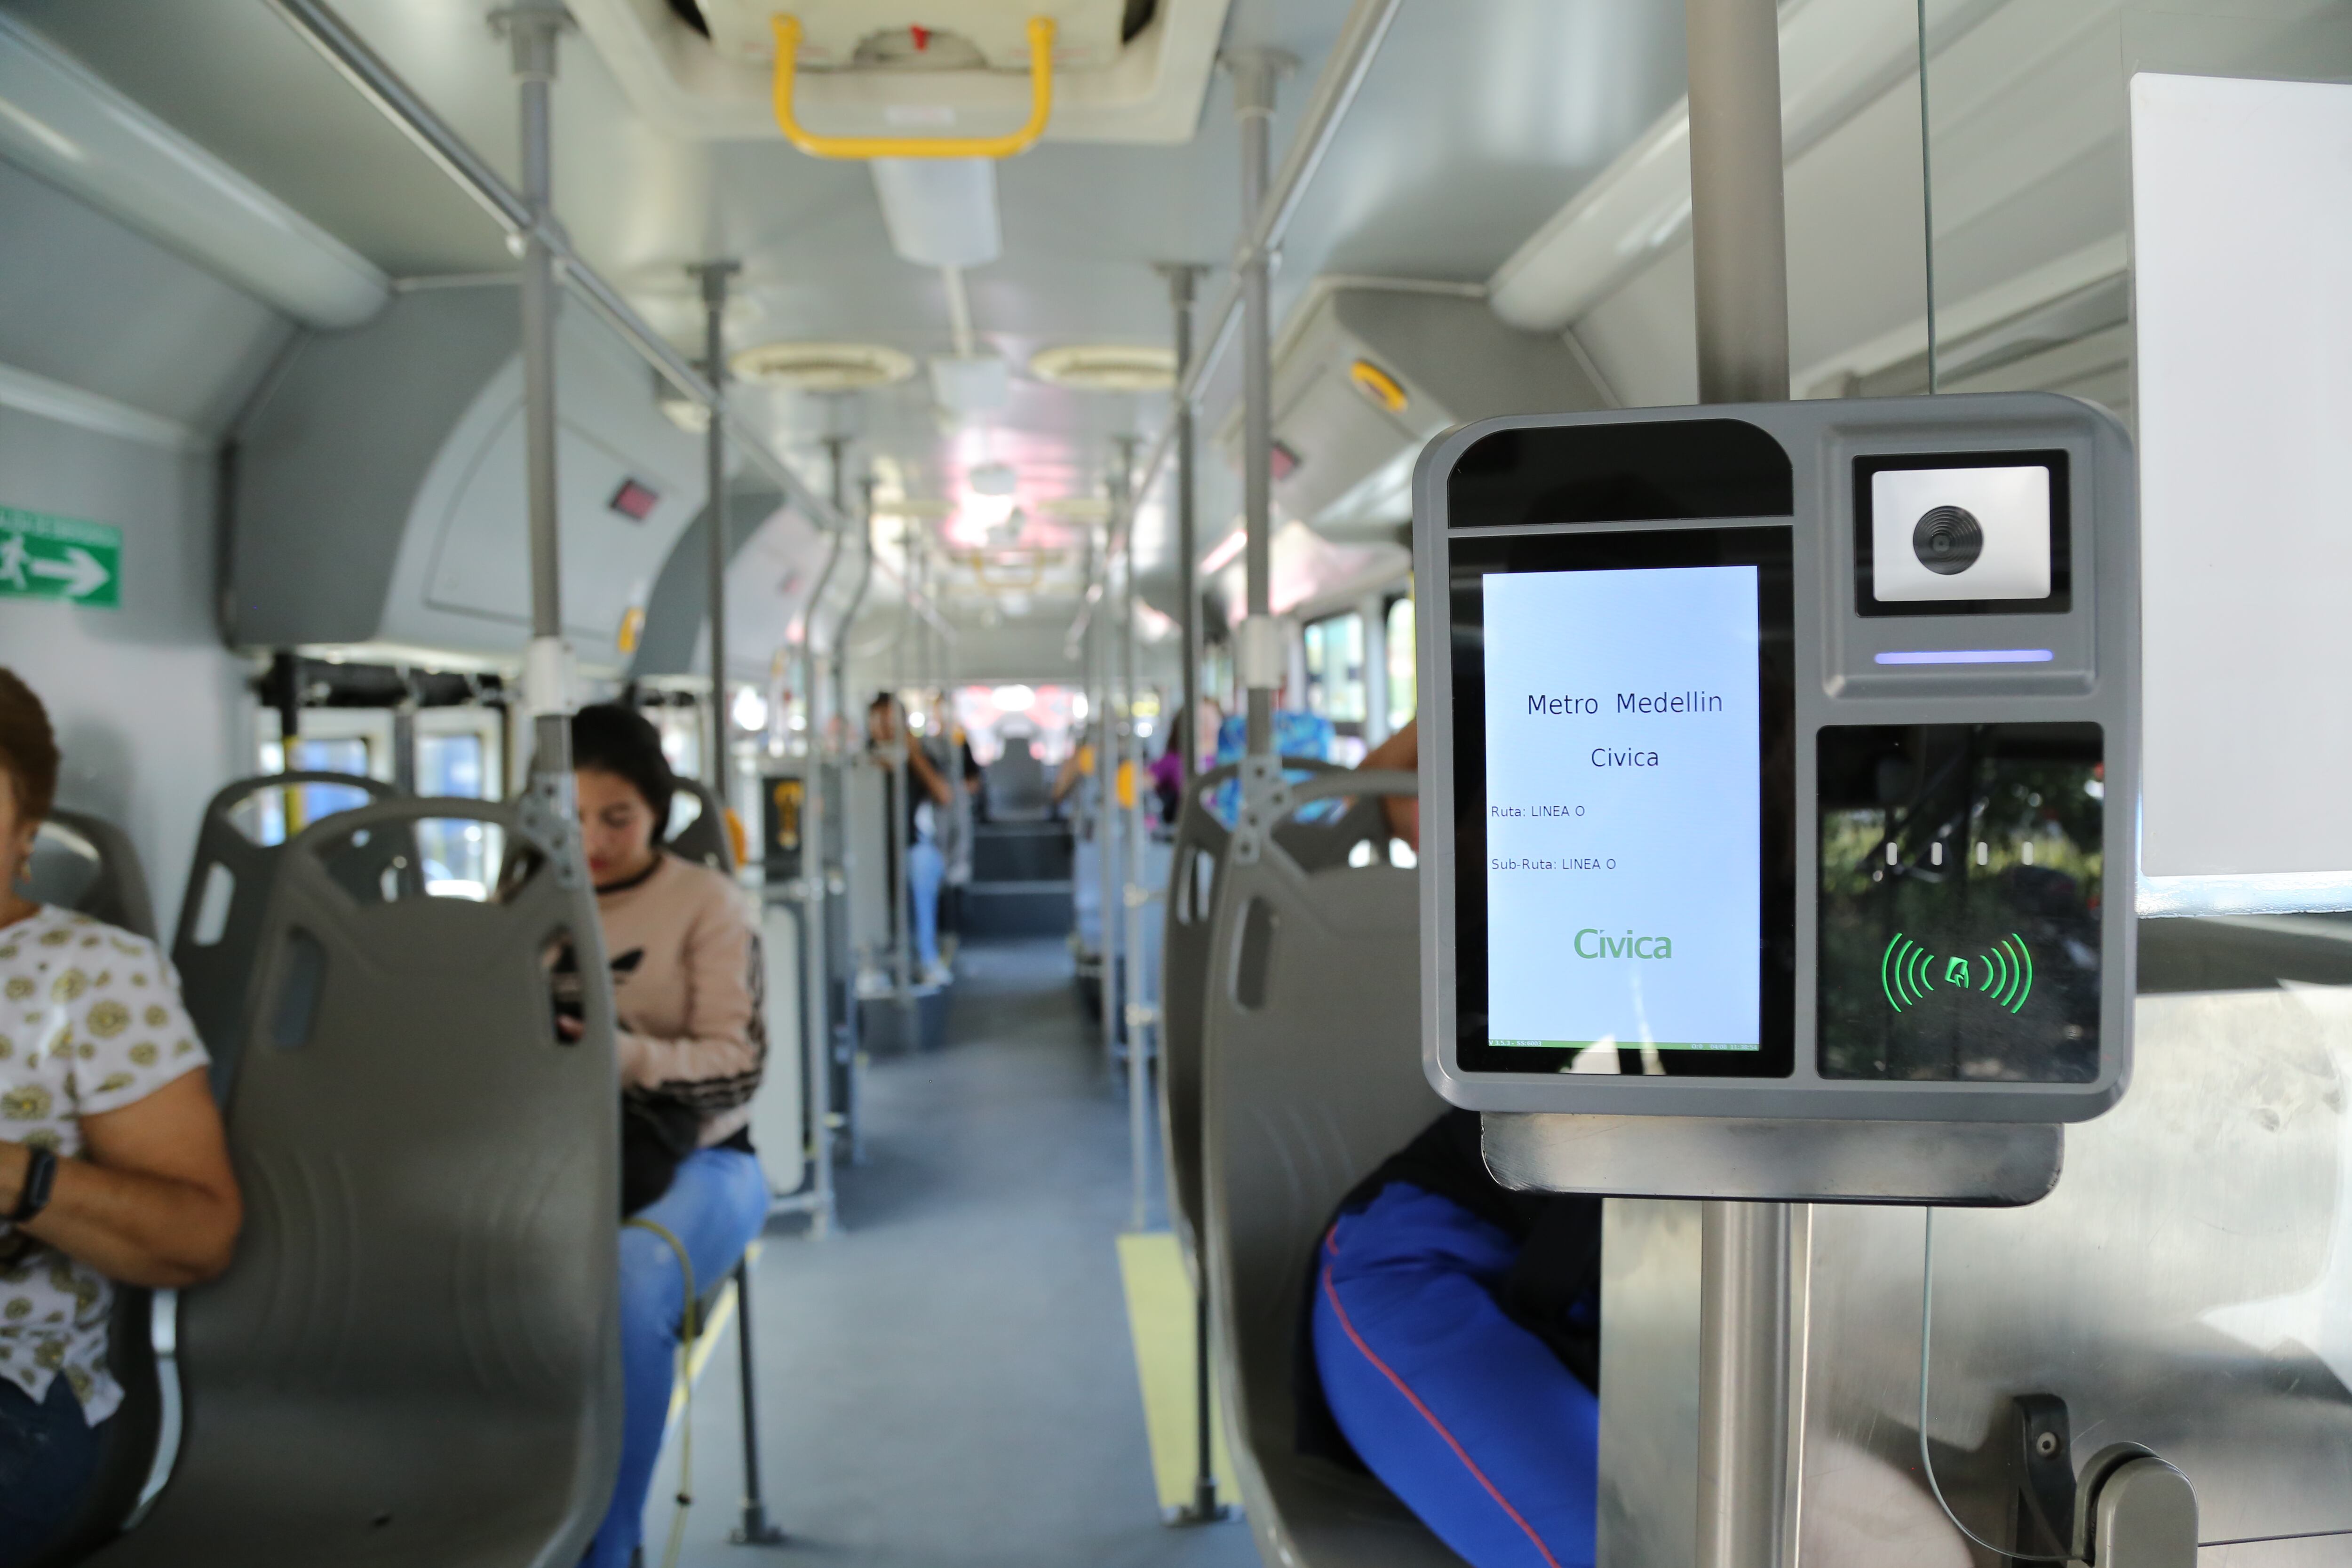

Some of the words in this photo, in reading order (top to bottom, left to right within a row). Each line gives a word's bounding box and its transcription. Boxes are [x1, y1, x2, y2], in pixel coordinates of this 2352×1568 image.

[1528, 694, 1598, 715] Metro
[1617, 691, 1723, 714] Medellin
[1591, 747, 1659, 768] Civica
[1492, 806, 1526, 817] Ruta:
[1531, 805, 1570, 817] LINEA
[1575, 805, 1585, 817] O
[1492, 858, 1557, 870] Sub-Ruta:
[1562, 858, 1601, 870] LINEA
[1606, 858, 1616, 869] O
